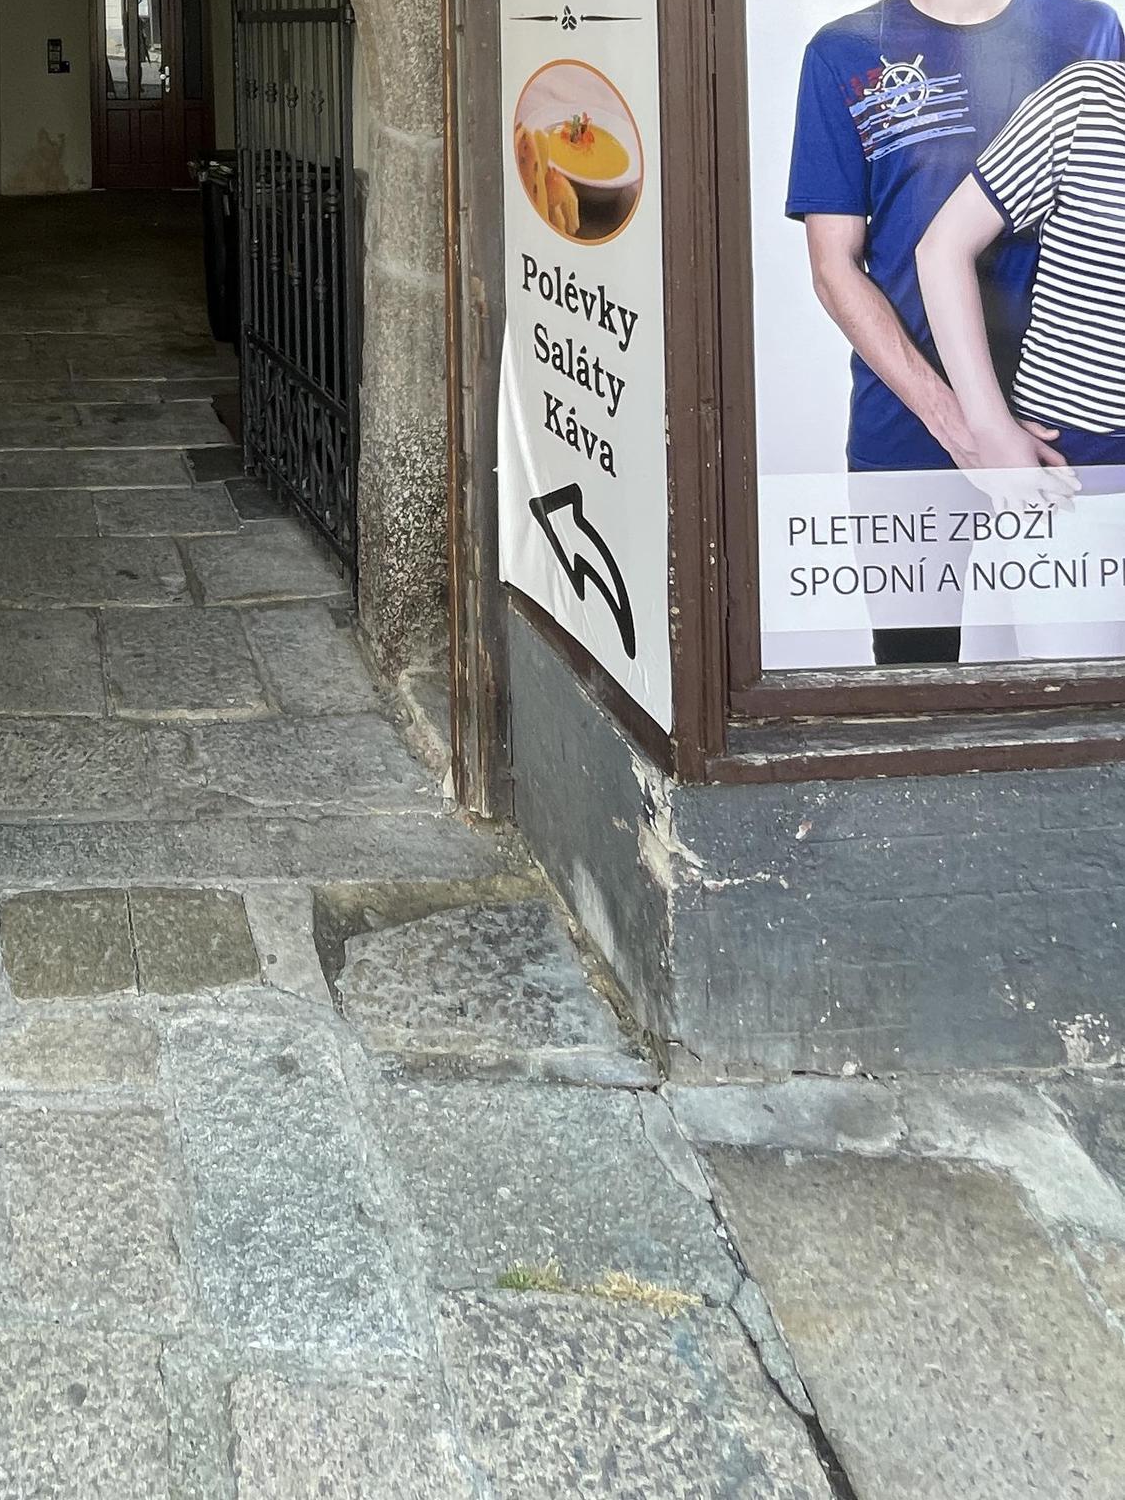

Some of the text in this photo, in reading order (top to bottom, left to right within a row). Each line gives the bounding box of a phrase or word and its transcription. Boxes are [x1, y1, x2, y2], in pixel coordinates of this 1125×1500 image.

[520, 252, 638, 353] Polévky
[533, 322, 626, 418] Saláty
[543, 390, 618, 479] Káva
[788, 502, 1055, 547] PLETENÉ ZBOŽÍ
[789, 551, 1125, 597] SPODNÍ A NOČNÍ P
